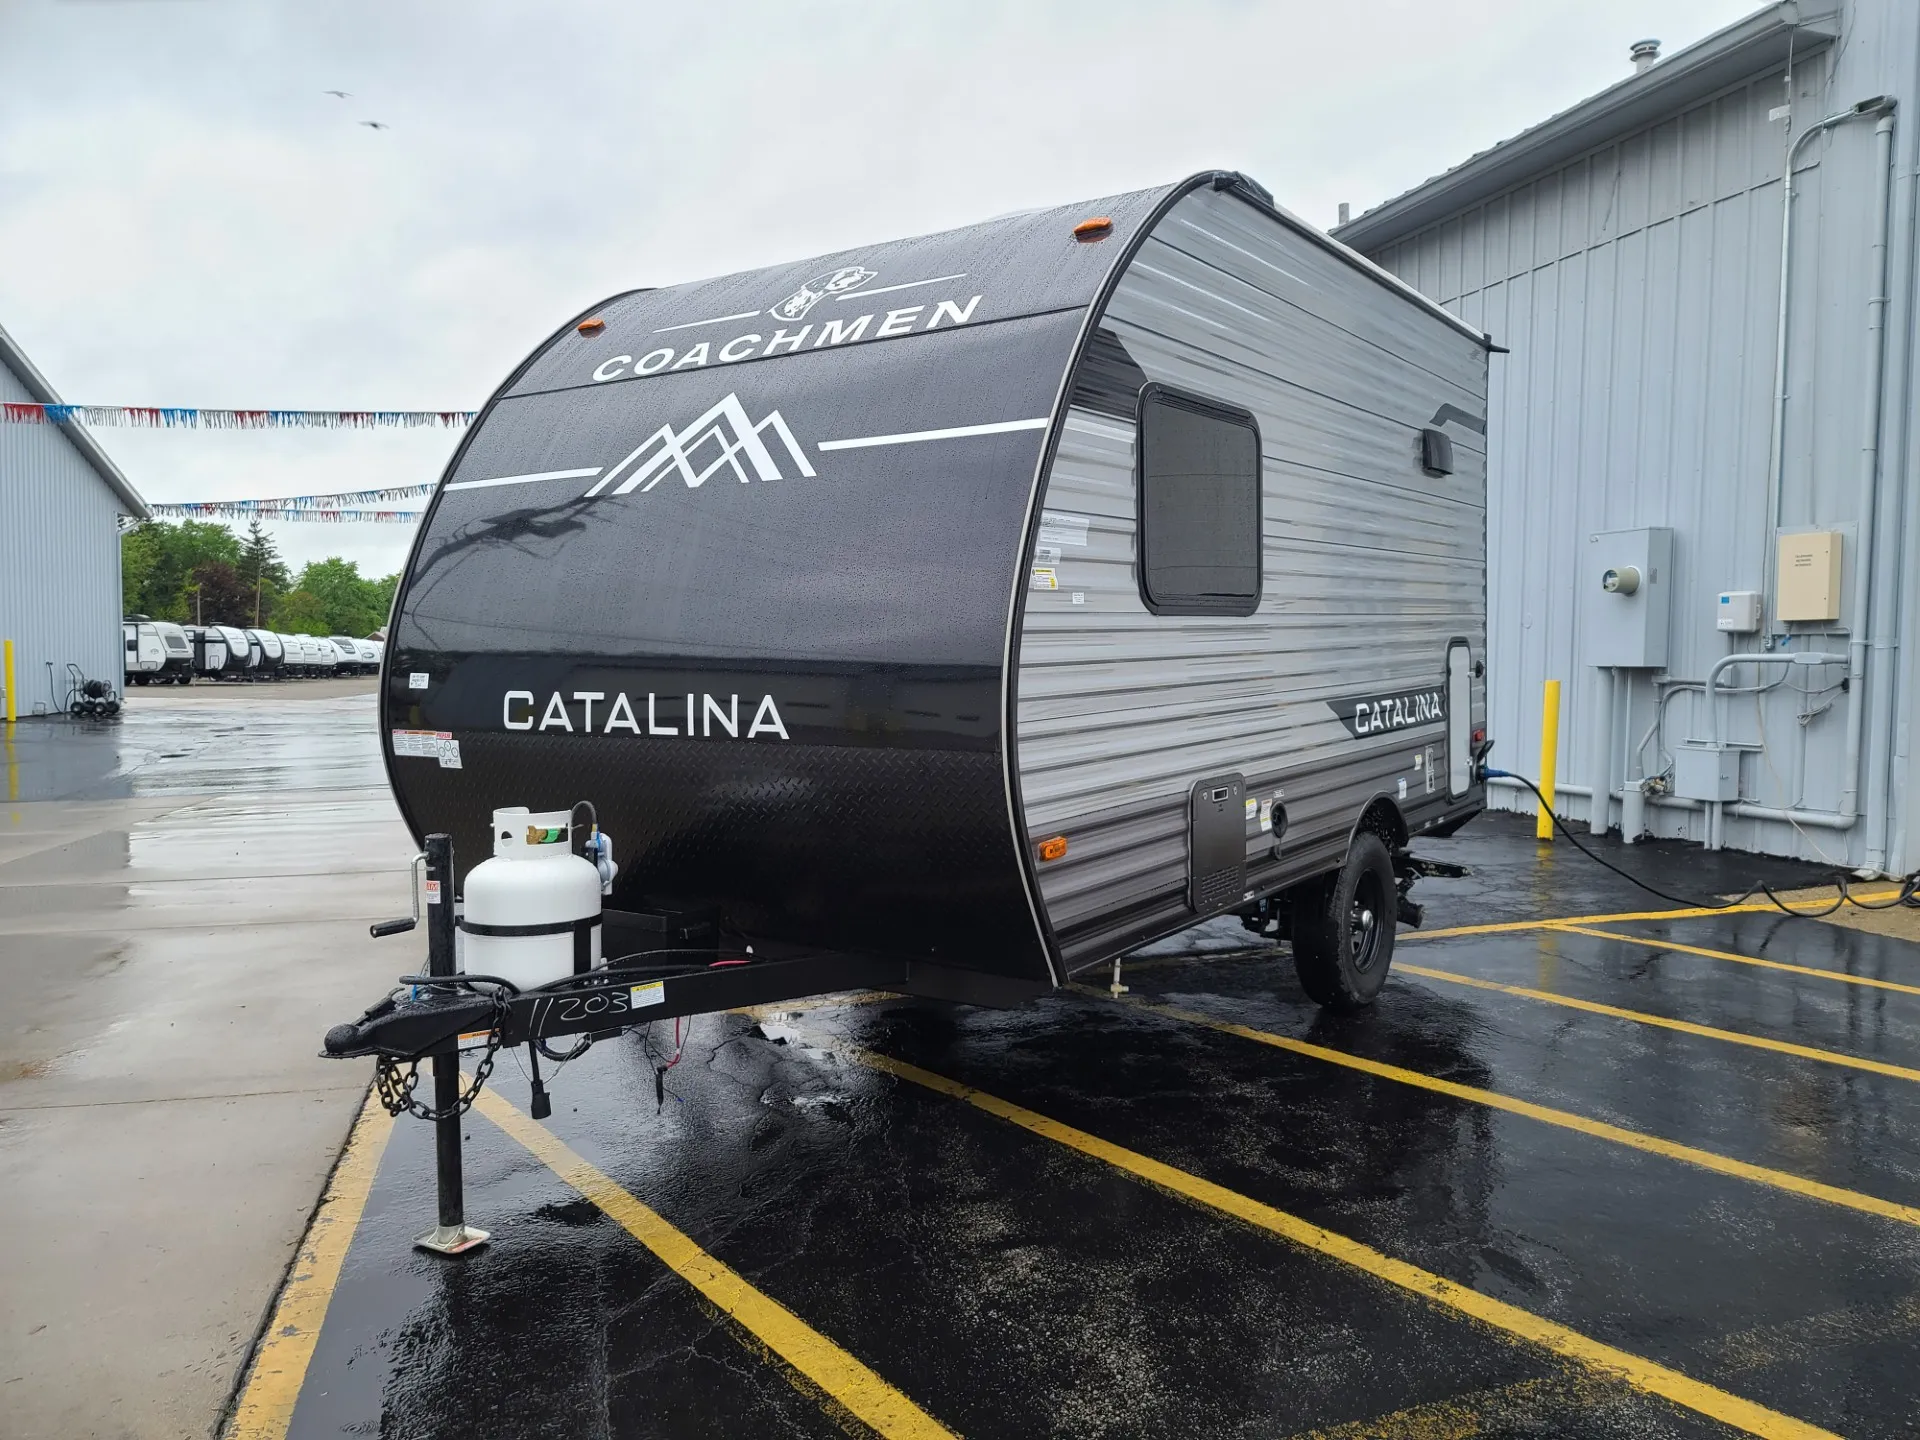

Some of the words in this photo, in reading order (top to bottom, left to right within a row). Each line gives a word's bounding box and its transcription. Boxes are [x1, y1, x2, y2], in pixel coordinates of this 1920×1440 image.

[592, 295, 983, 381] COACHMEN
[503, 690, 790, 740] CATALINA
[1355, 692, 1443, 733] CATALINA
[528, 992, 629, 1037] 11203
